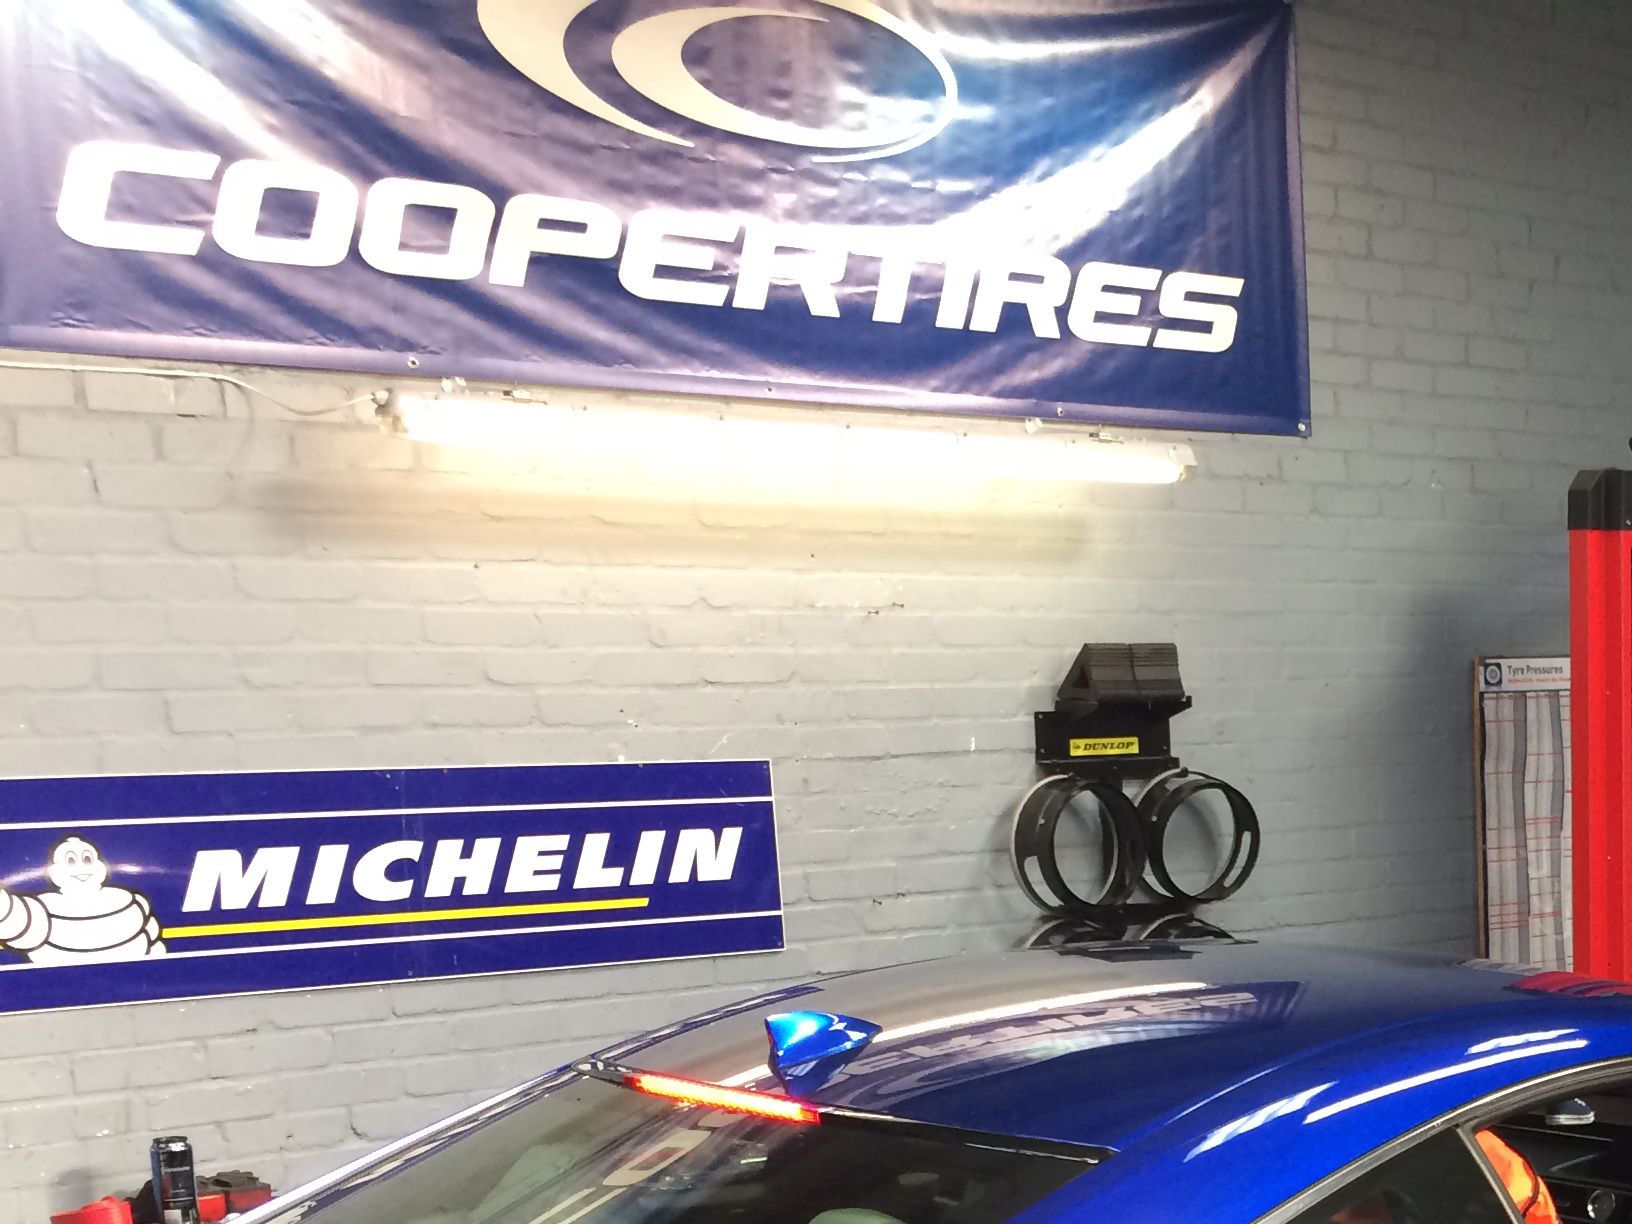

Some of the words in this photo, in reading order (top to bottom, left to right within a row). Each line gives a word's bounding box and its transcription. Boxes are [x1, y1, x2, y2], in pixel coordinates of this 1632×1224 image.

[1507, 665, 1524, 677] Tyre
[1526, 664, 1563, 674] Pressures
[1083, 742, 1135, 751] DUNLOP
[182, 827, 743, 912] MICHELIN
